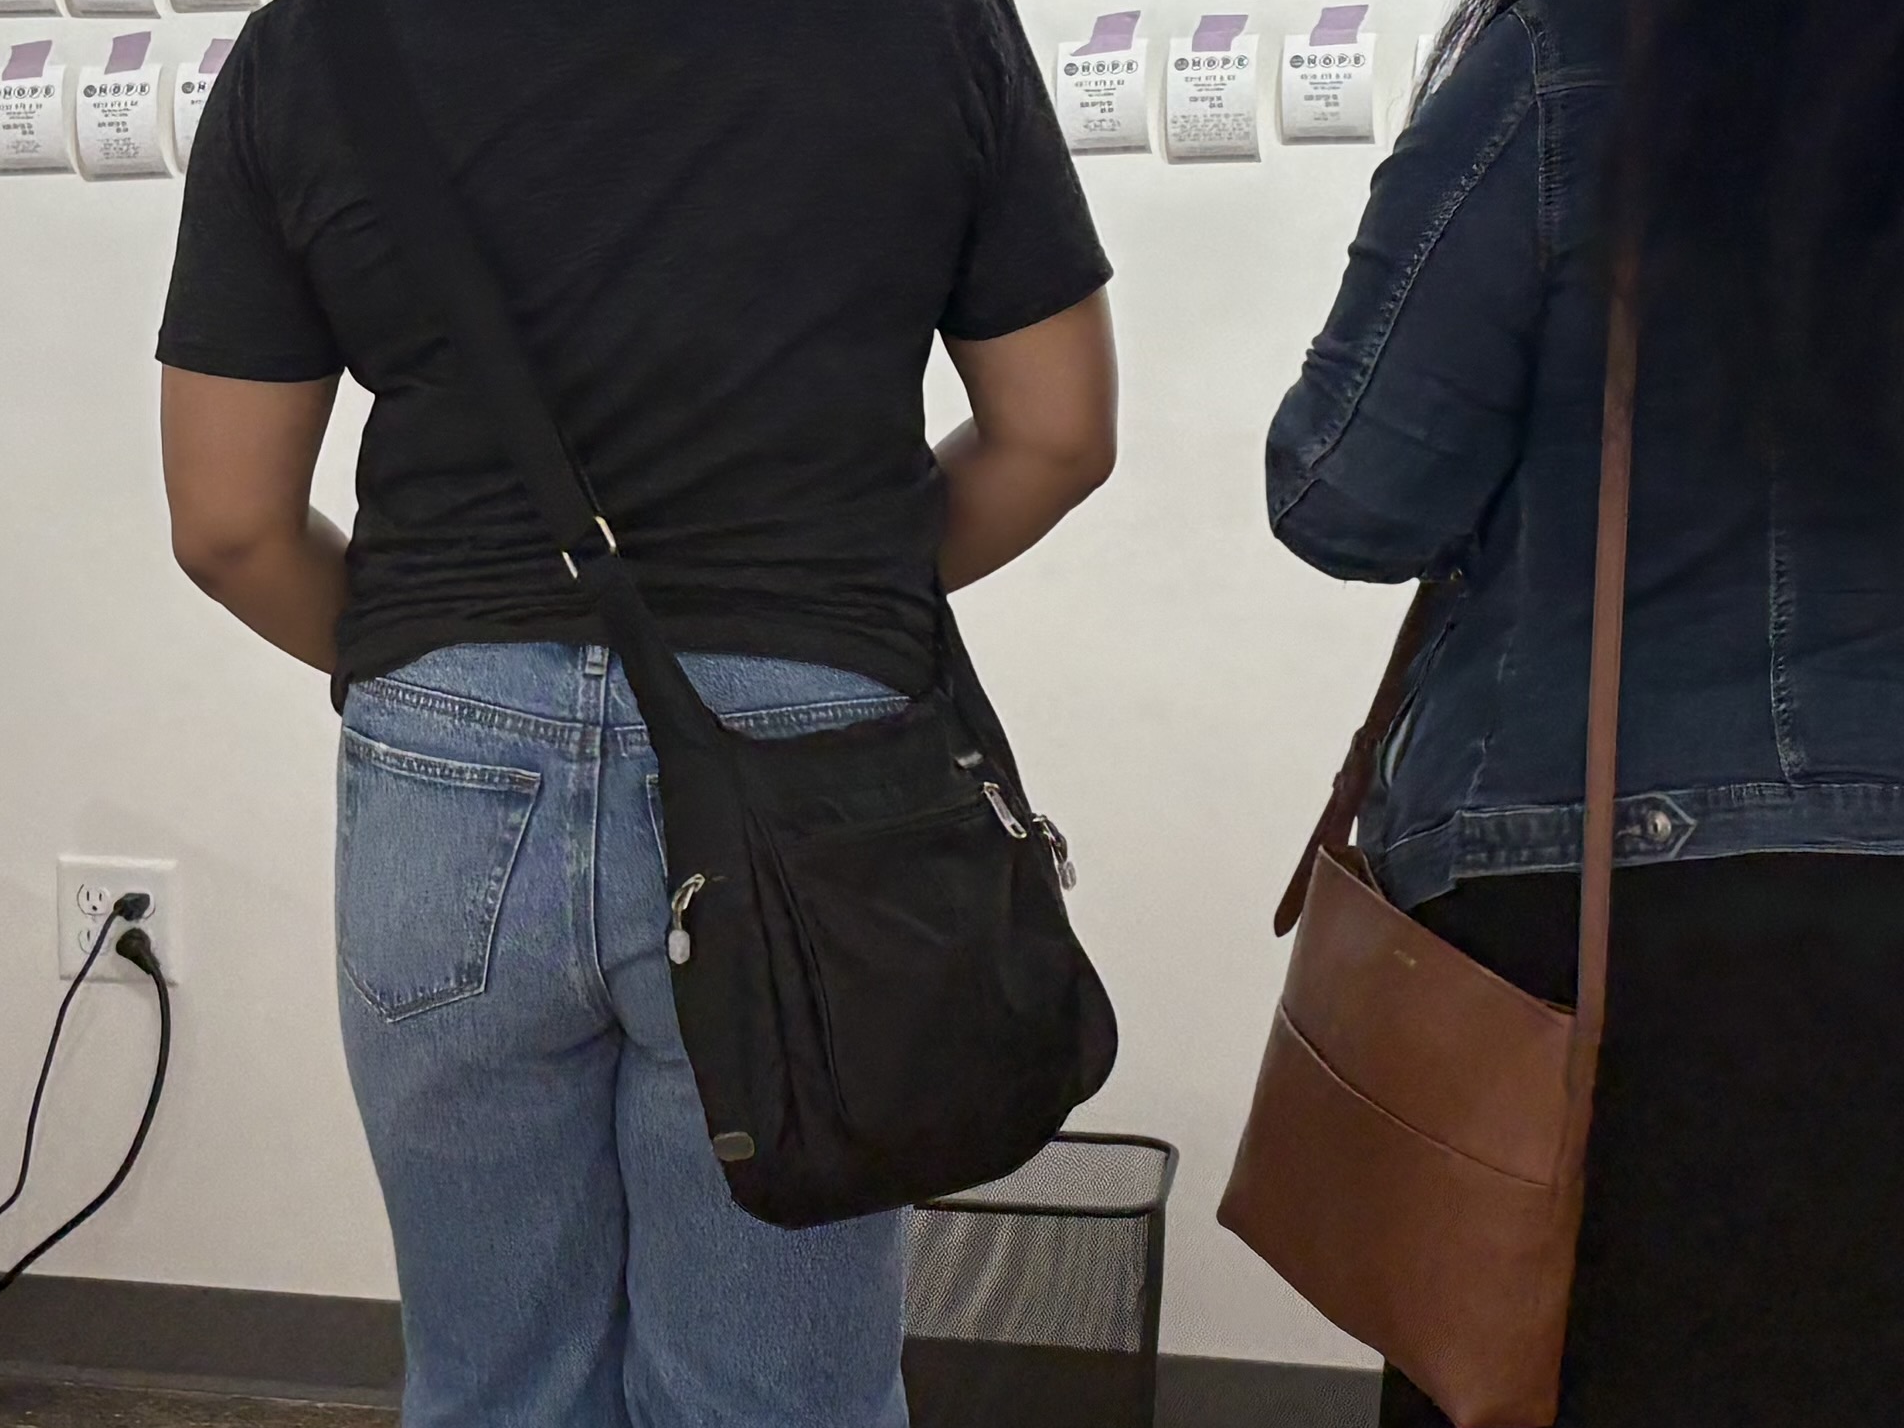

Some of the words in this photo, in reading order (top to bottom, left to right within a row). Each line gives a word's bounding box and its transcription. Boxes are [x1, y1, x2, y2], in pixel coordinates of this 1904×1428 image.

[1081, 61, 1137, 75] HOPE
[1191, 56, 1247, 70] HOPE
[1307, 55, 1363, 68] HOPE
[4, 85, 55, 98] HOPE
[100, 83, 149, 95] HOPE
